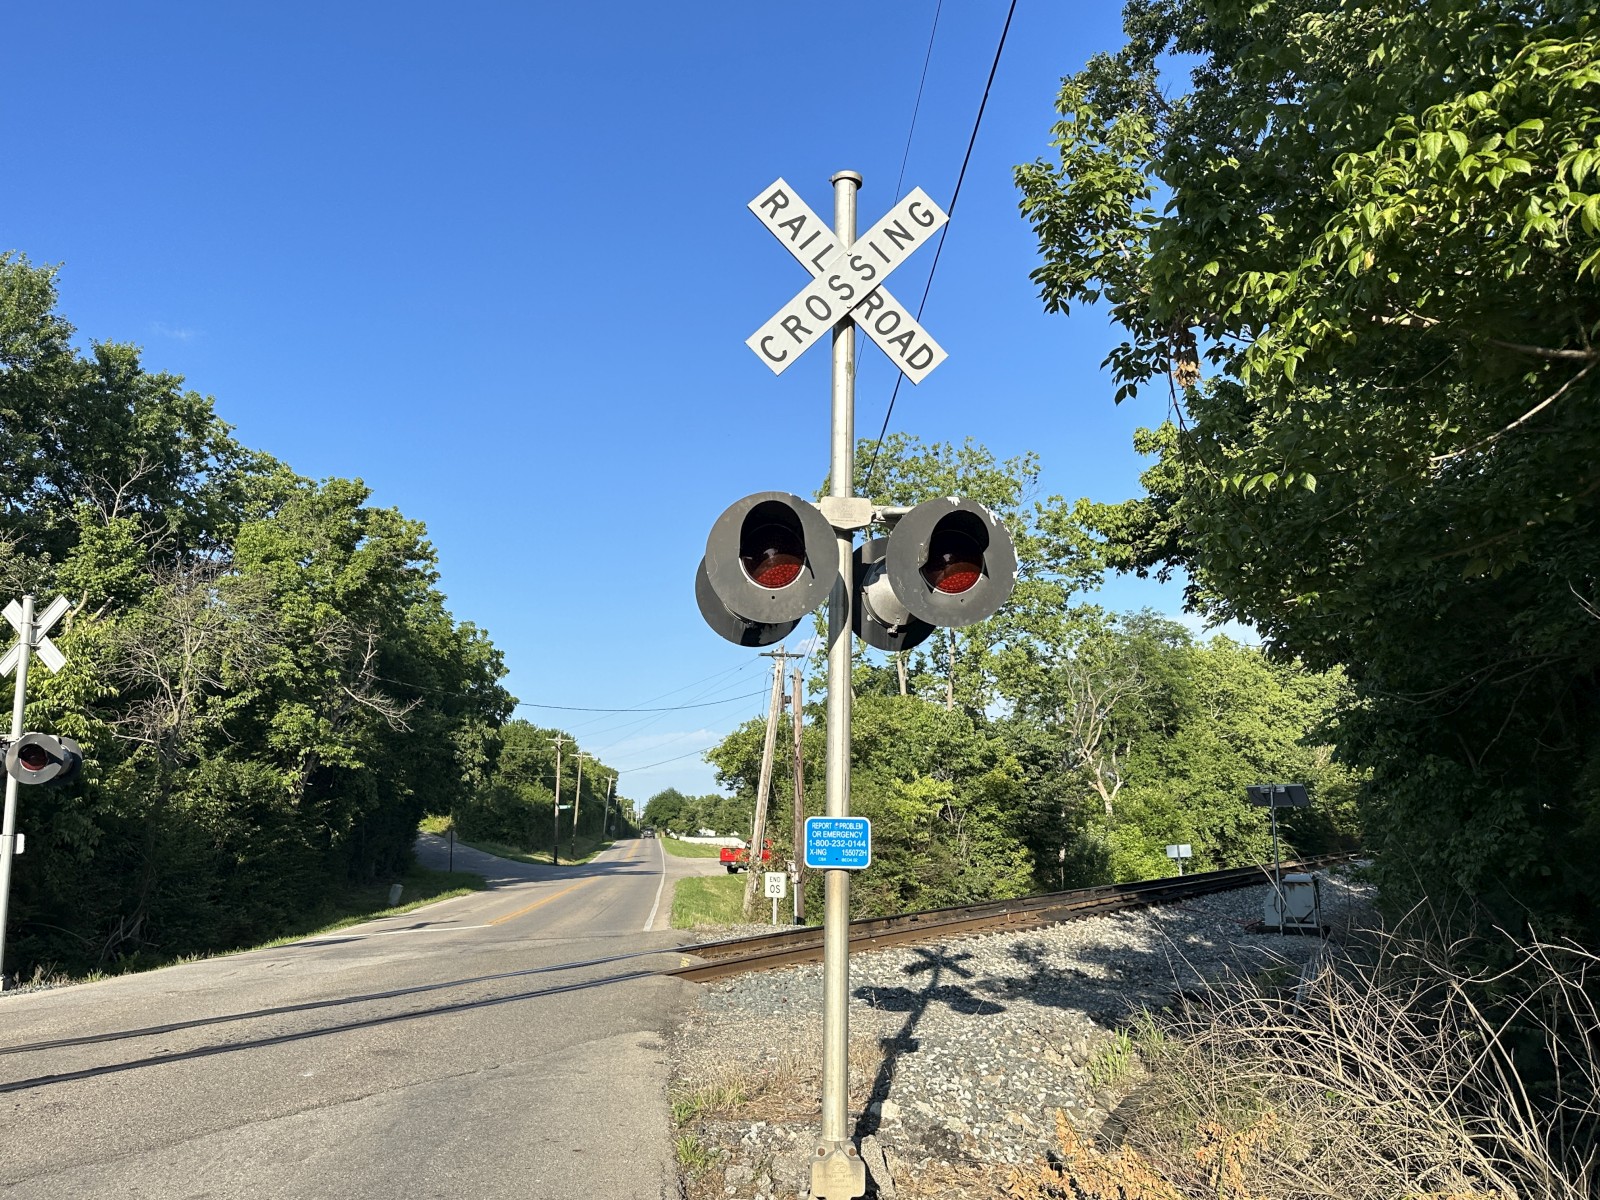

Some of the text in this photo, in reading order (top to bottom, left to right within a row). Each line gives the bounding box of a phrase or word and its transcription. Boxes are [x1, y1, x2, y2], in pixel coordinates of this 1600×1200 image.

[760, 189, 934, 370] RAIL ROAD
[760, 201, 935, 363] CROSSING
[811, 822, 832, 830] REPORT
[839, 822, 864, 830] PROBLEM
[811, 830, 863, 839] OR EMERGENCY
[809, 839, 866, 848] 1-800-232-0144
[809, 848, 827, 856] X-ING
[769, 884, 781, 894] OS
